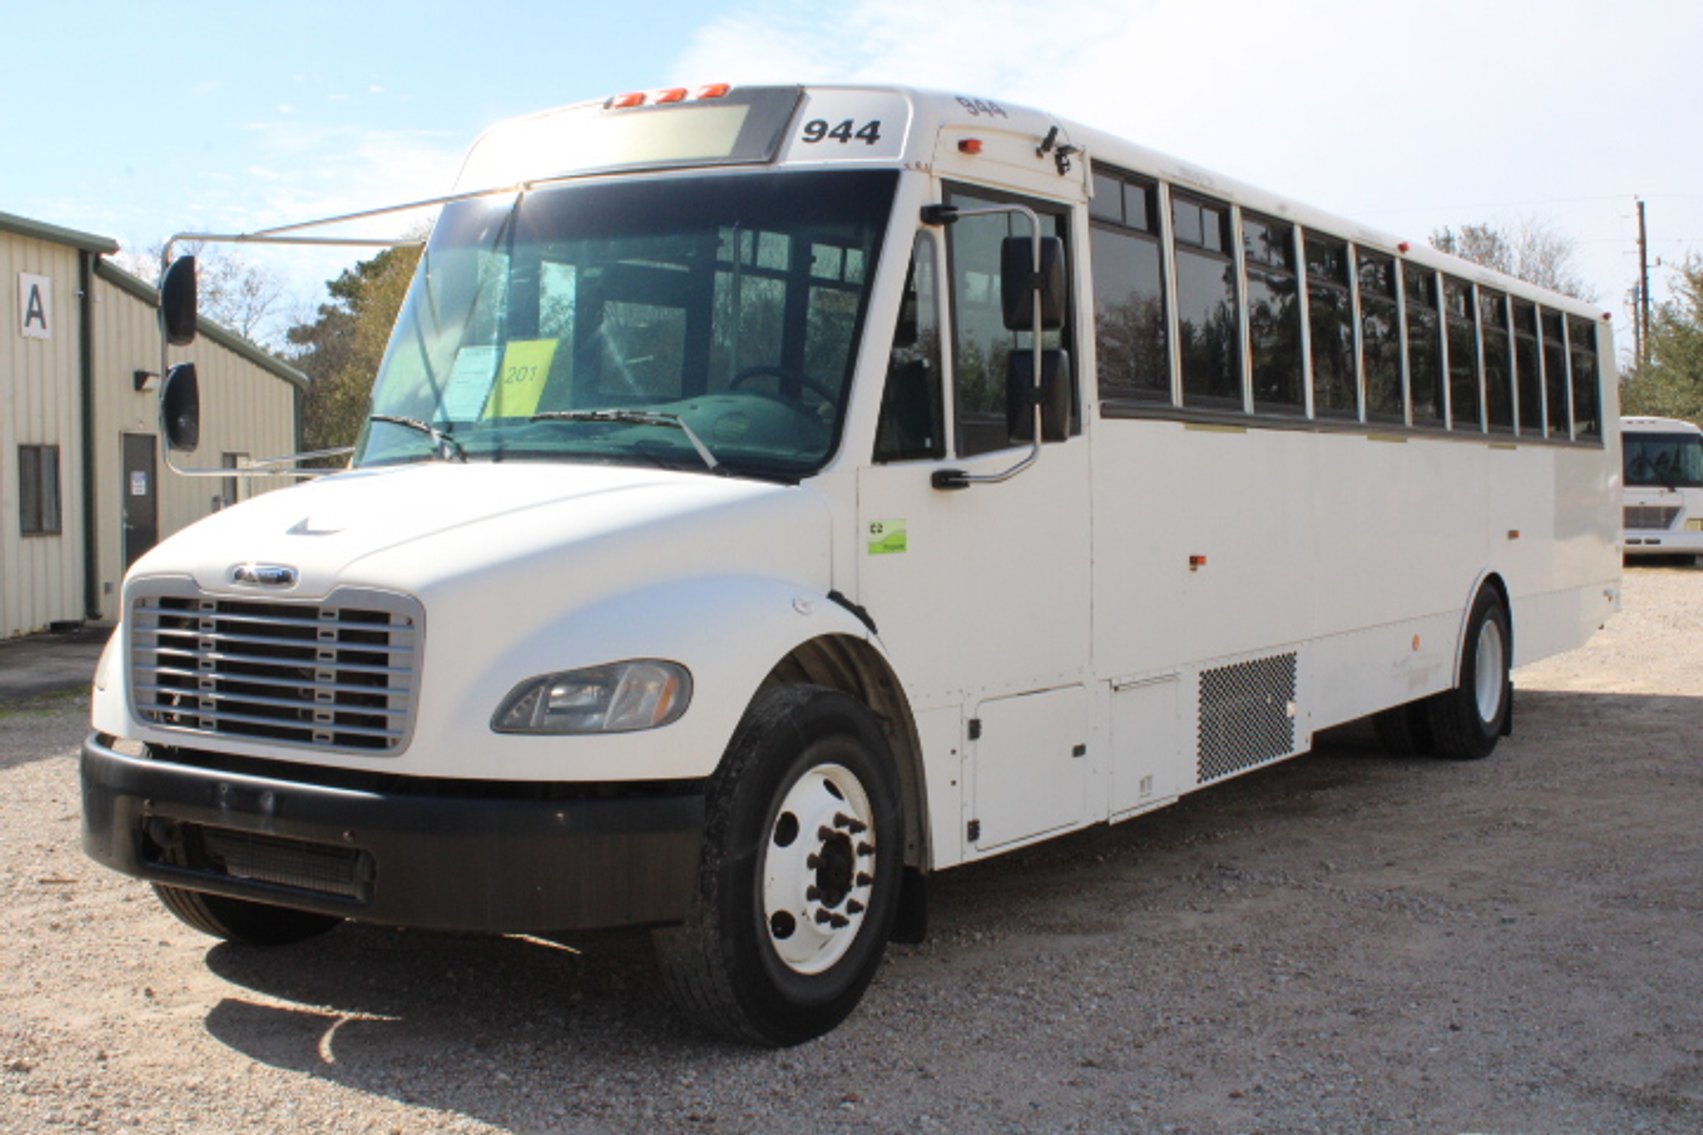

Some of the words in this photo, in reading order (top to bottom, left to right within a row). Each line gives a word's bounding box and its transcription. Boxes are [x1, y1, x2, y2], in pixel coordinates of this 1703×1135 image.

[955, 97, 1009, 119] 944
[802, 119, 881, 146] 944
[24, 283, 47, 331] A
[504, 366, 538, 384] 201
